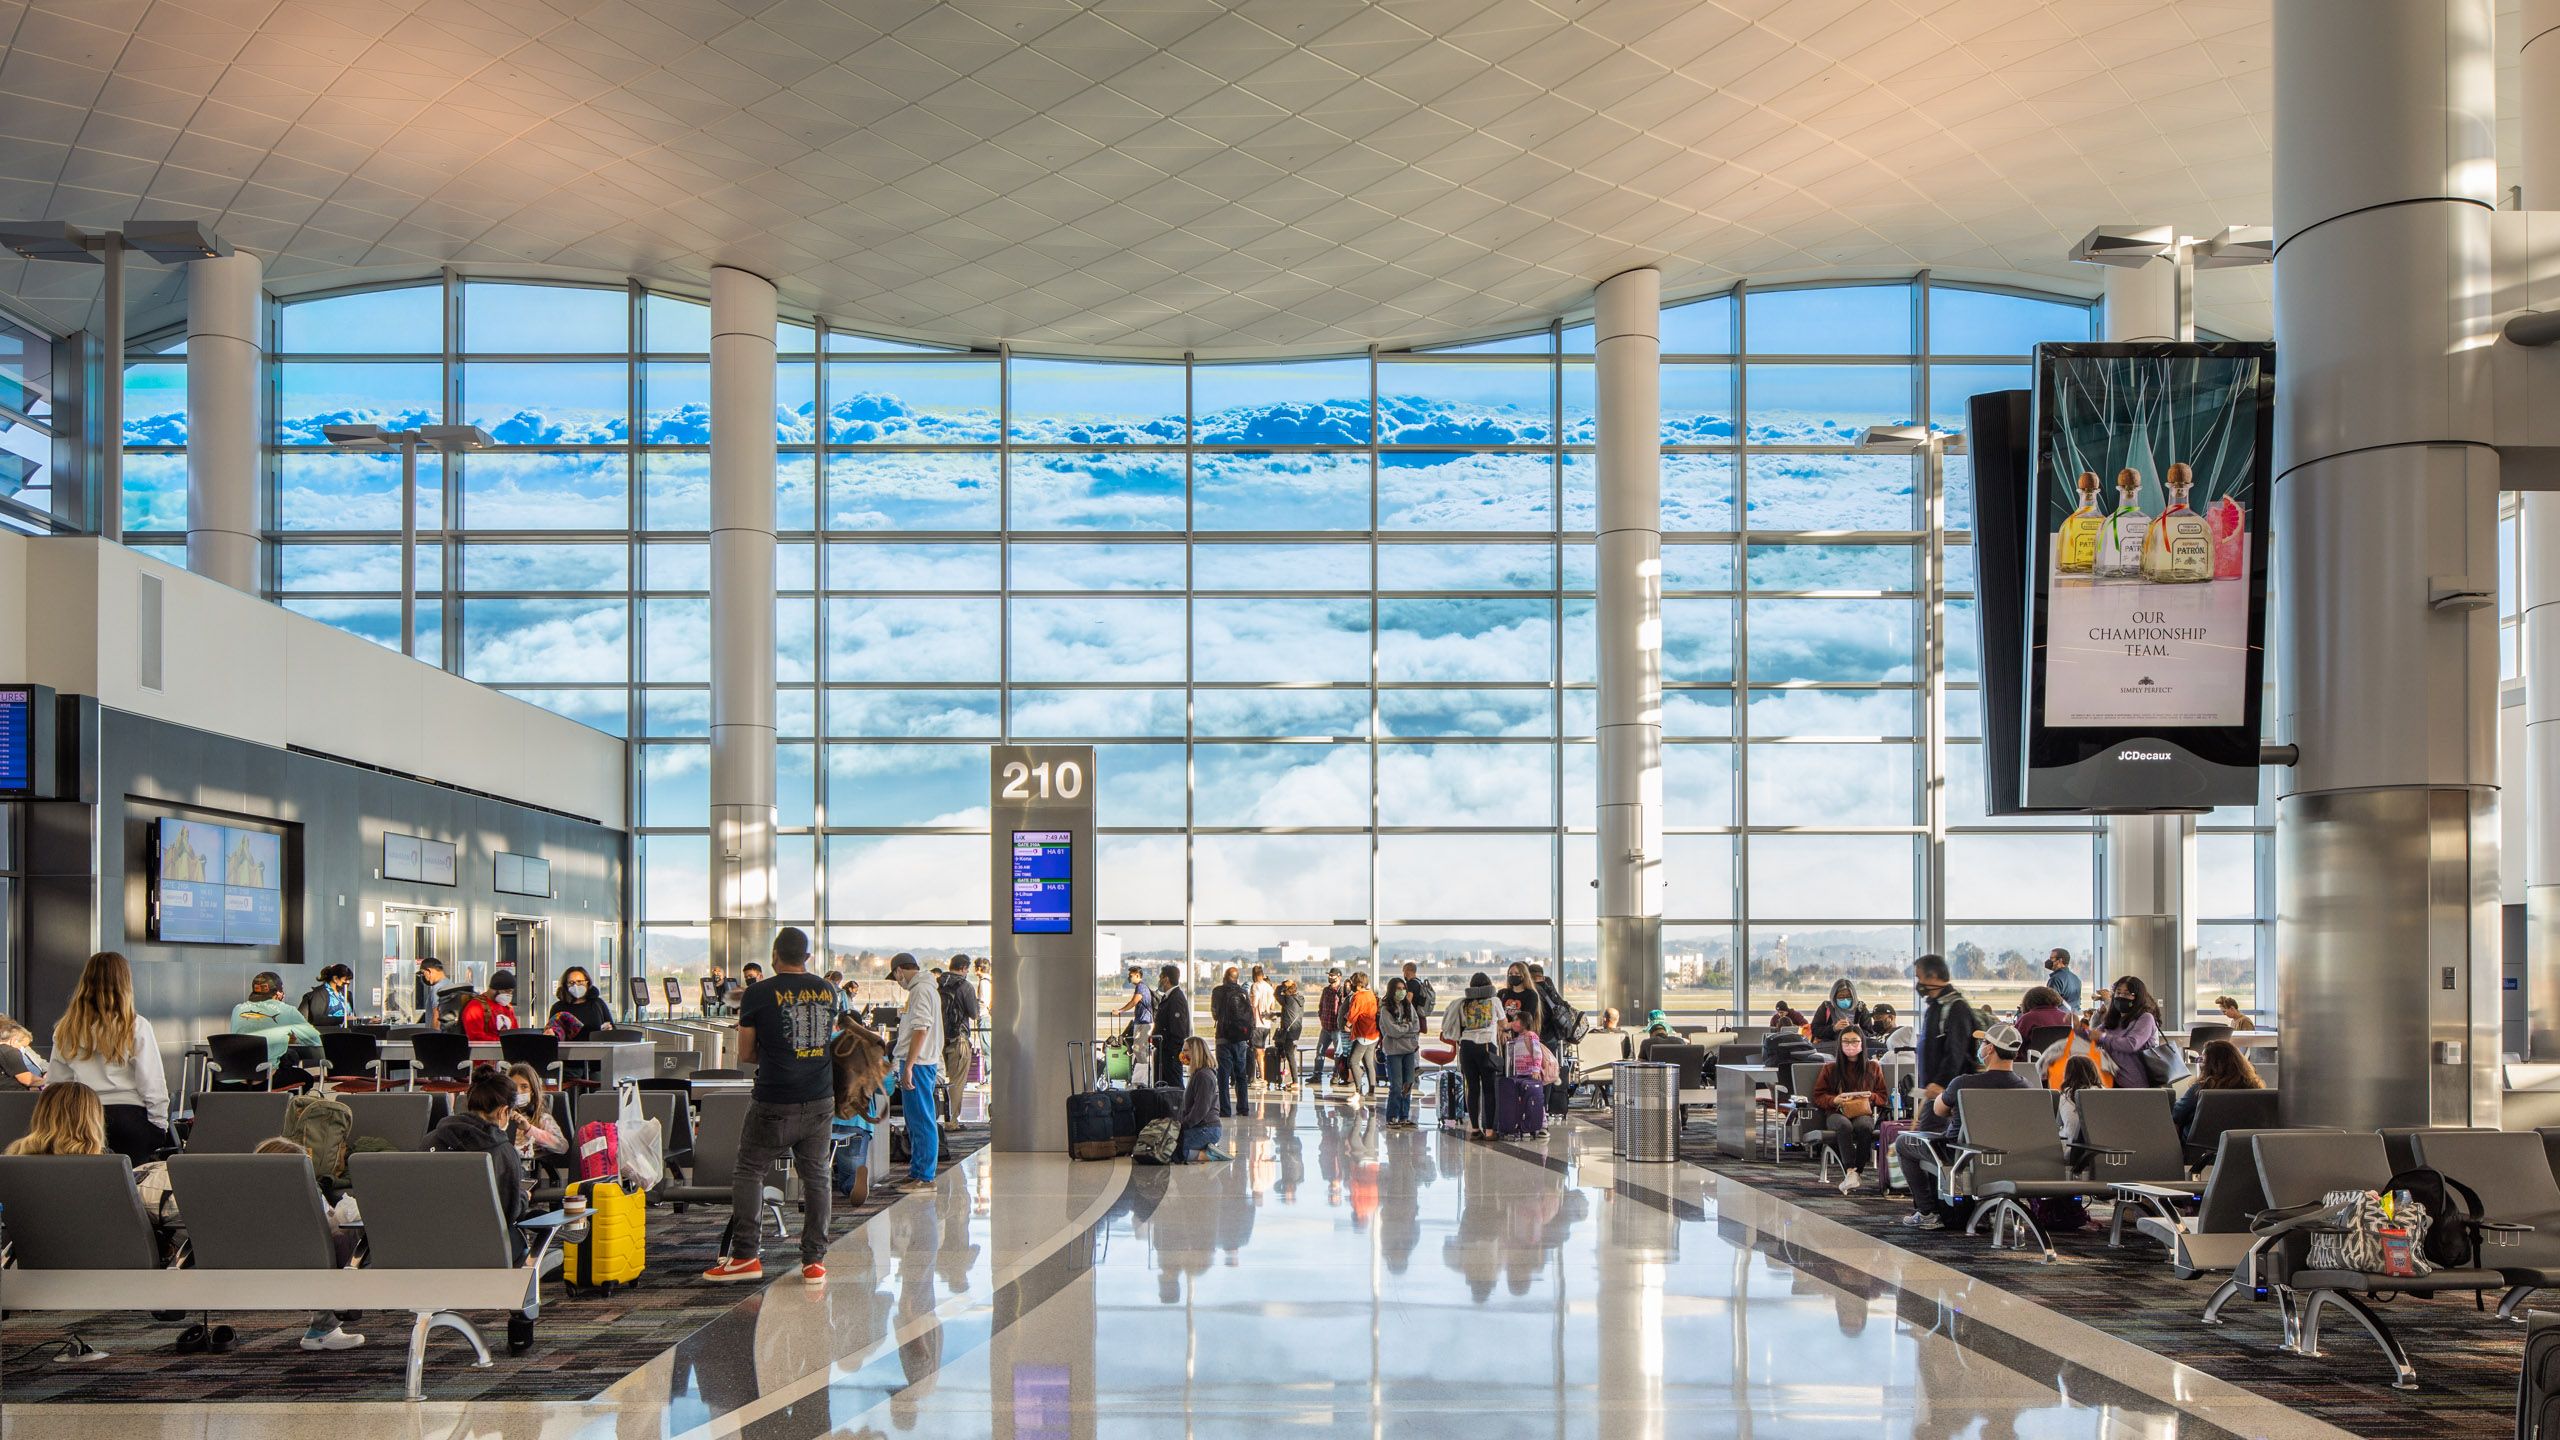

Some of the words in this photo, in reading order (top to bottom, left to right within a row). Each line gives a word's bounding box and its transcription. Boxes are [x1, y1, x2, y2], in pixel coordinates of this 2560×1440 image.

[2132, 611, 2166, 624] OUR
[2089, 627, 2207, 640] CHAMPIONSHIP
[2124, 644, 2170, 657] TEAM.
[0, 693, 25, 702] URES
[2118, 751, 2172, 761] JCDecaux
[1002, 761, 1082, 799] 210
